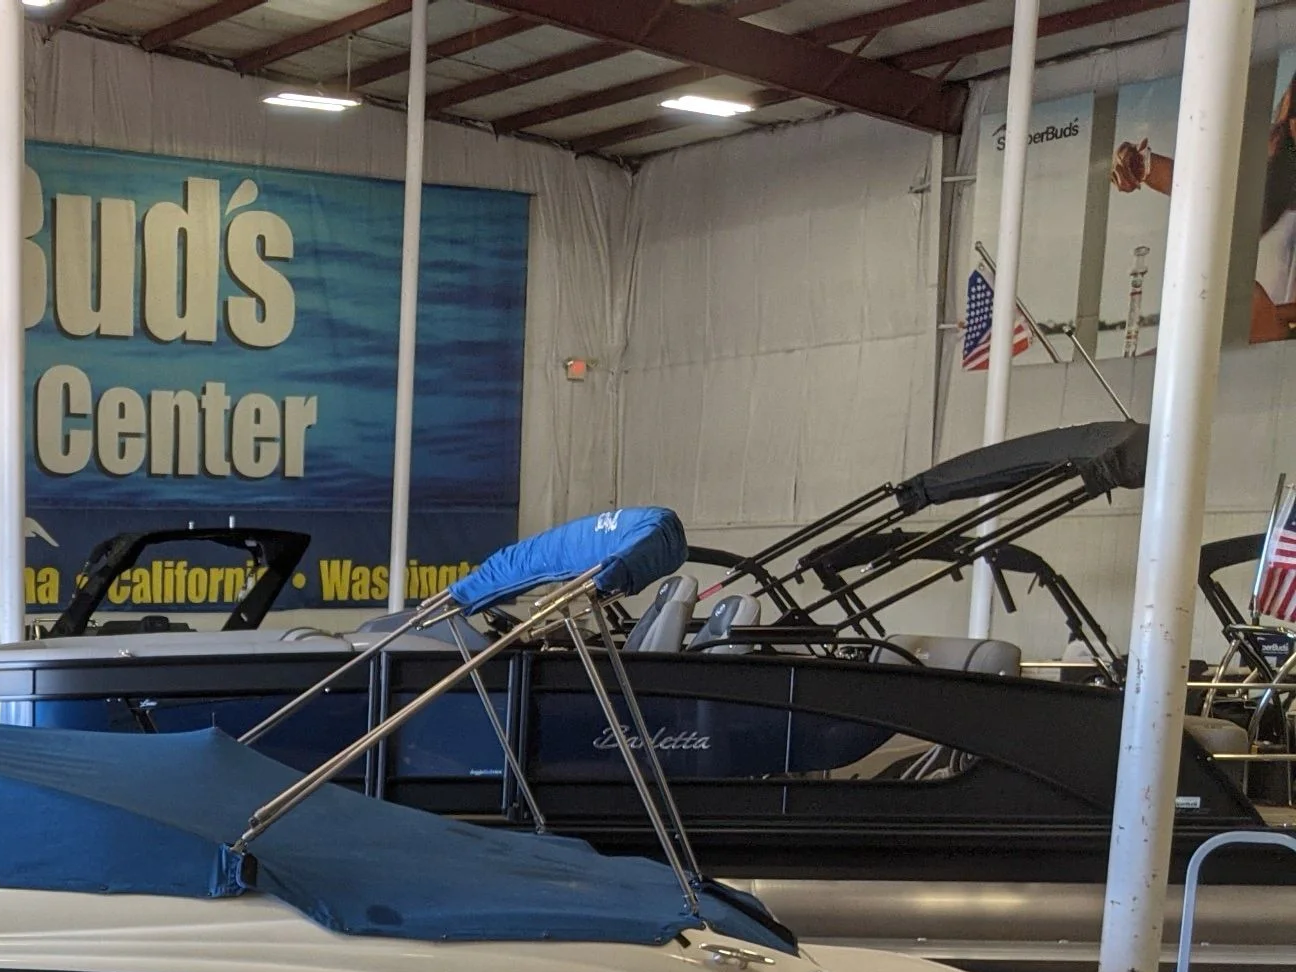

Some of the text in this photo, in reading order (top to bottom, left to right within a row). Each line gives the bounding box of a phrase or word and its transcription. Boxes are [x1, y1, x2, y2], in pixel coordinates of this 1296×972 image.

[997, 117, 1079, 151] SerBud's
[36, 364, 317, 478] Center
[108, 560, 268, 604] Californ
[592, 725, 711, 750] Baletta
